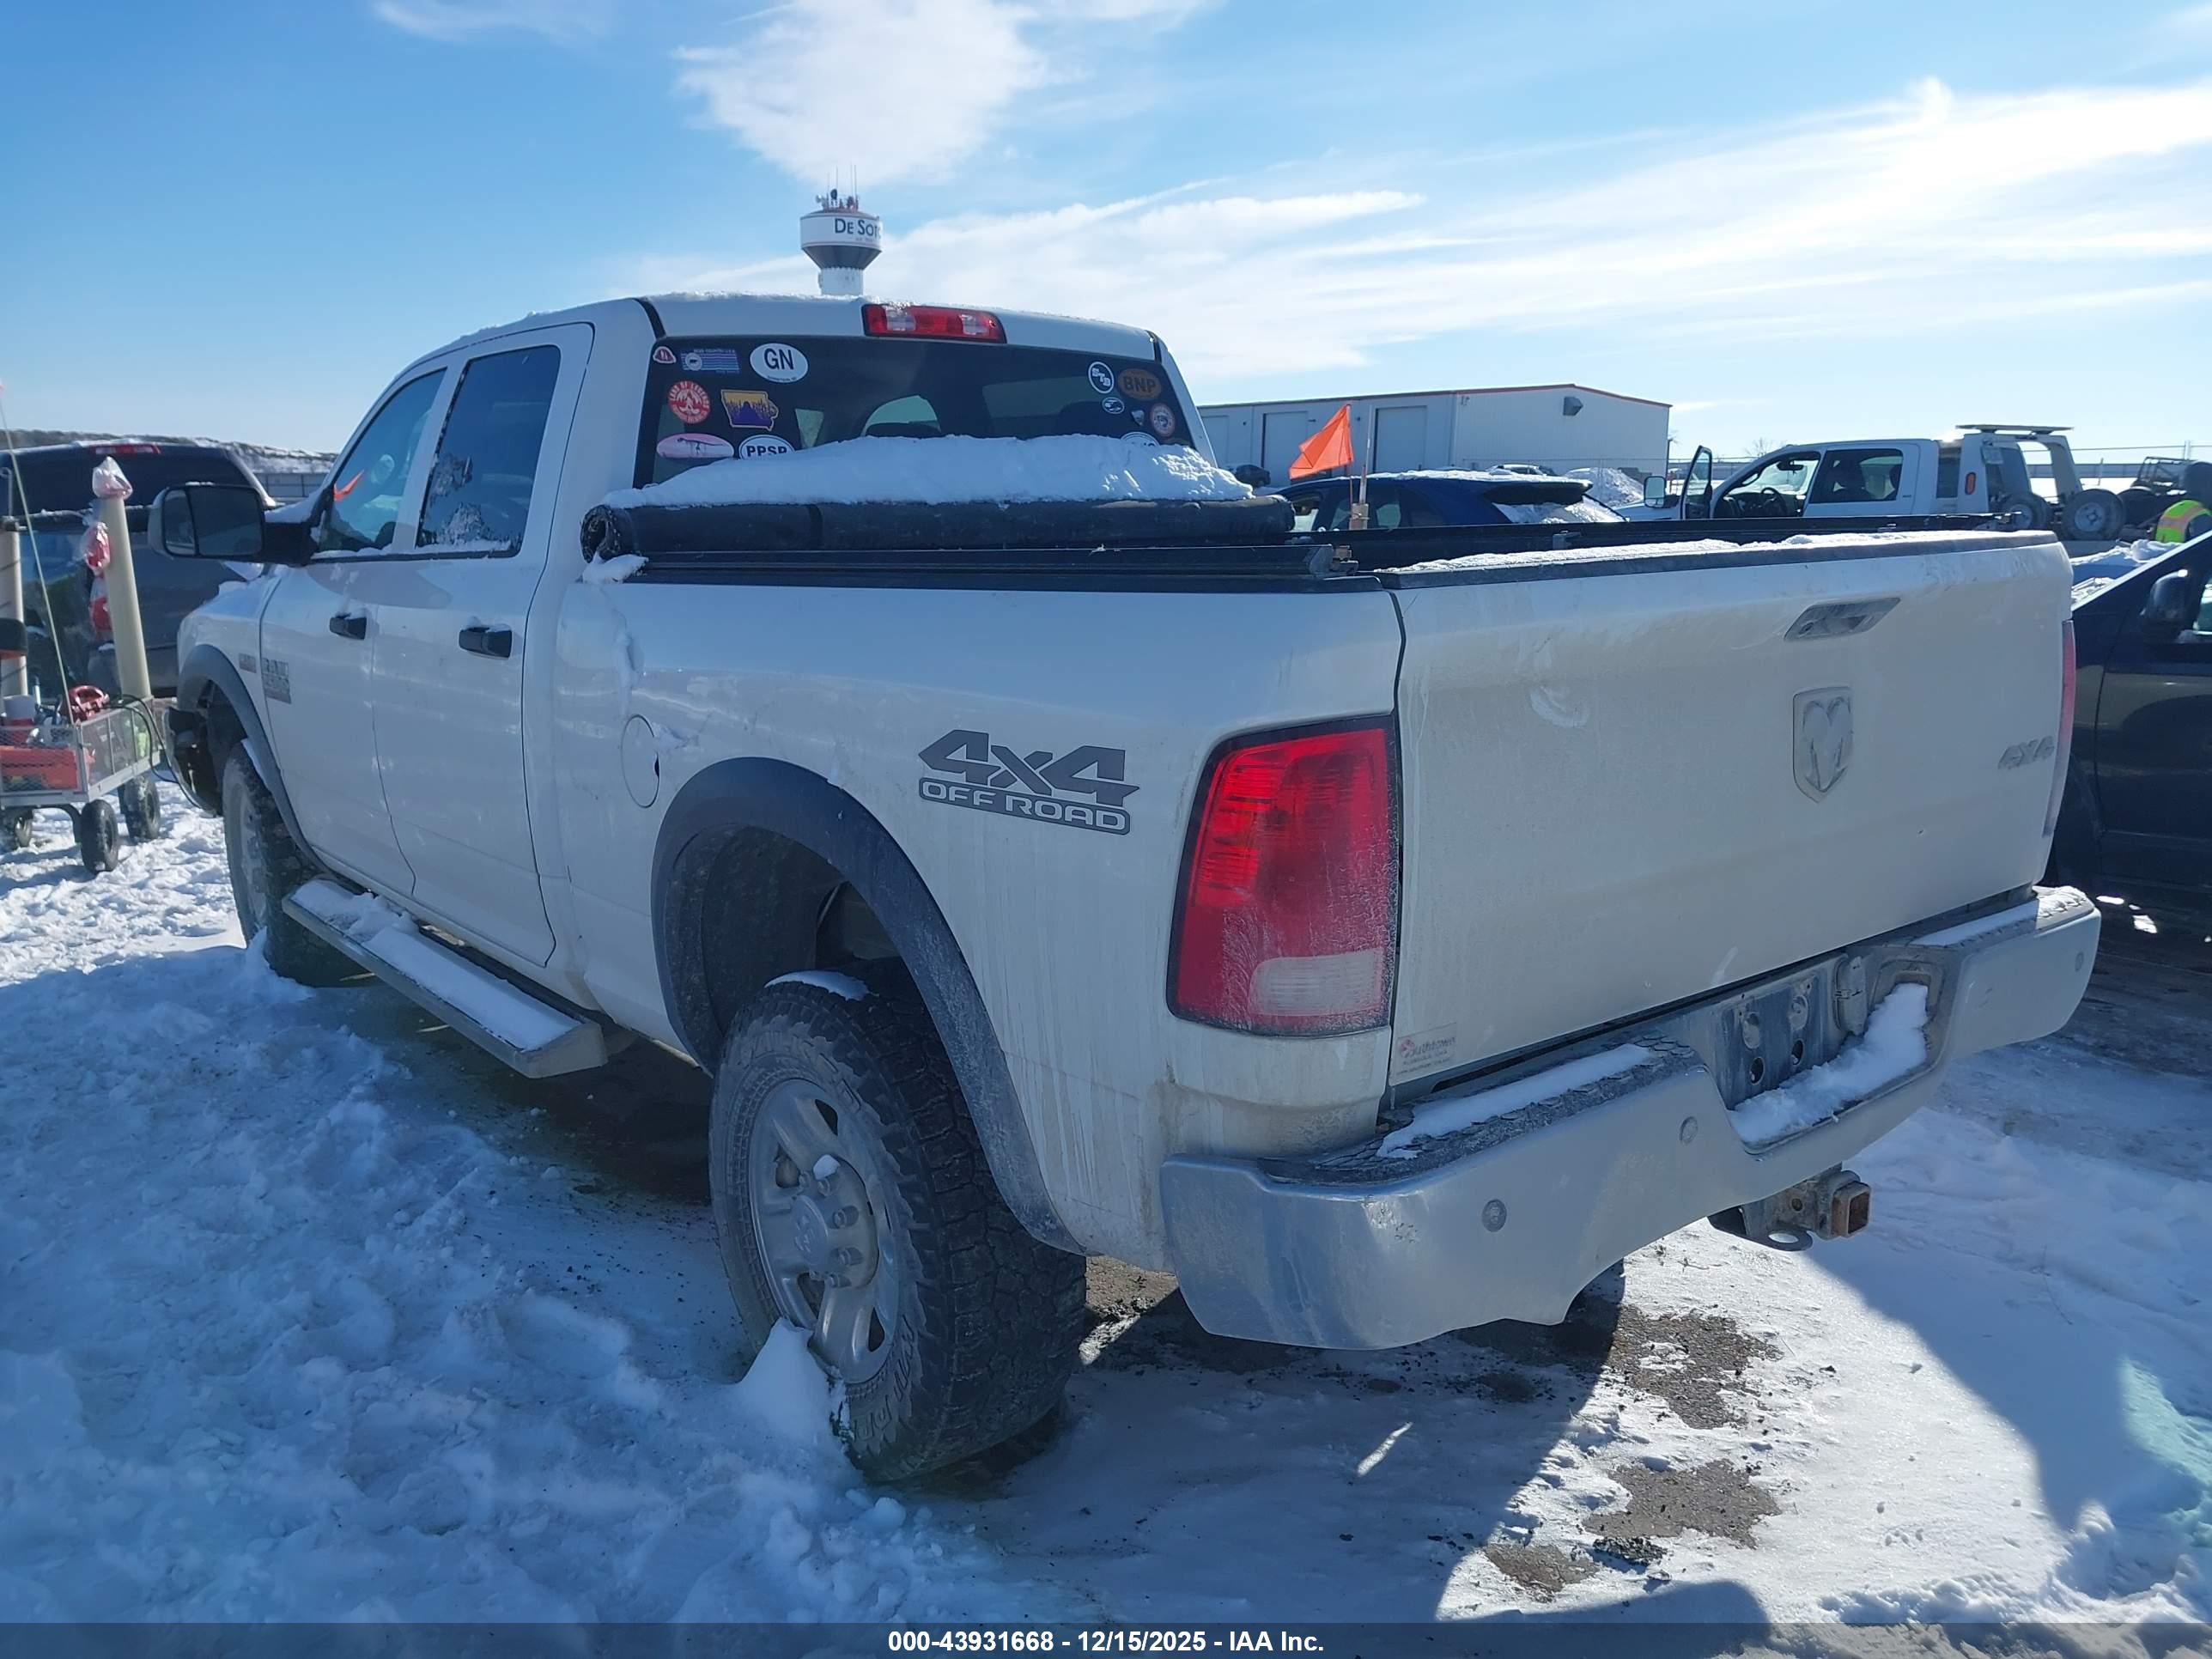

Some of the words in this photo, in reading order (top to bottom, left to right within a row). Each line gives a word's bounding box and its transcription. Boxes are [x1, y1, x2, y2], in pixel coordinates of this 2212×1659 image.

[764, 348, 794, 370] GN
[1123, 376, 1156, 393] BNP
[921, 781, 997, 805] OFF
[1005, 794, 1126, 830] ROAD
